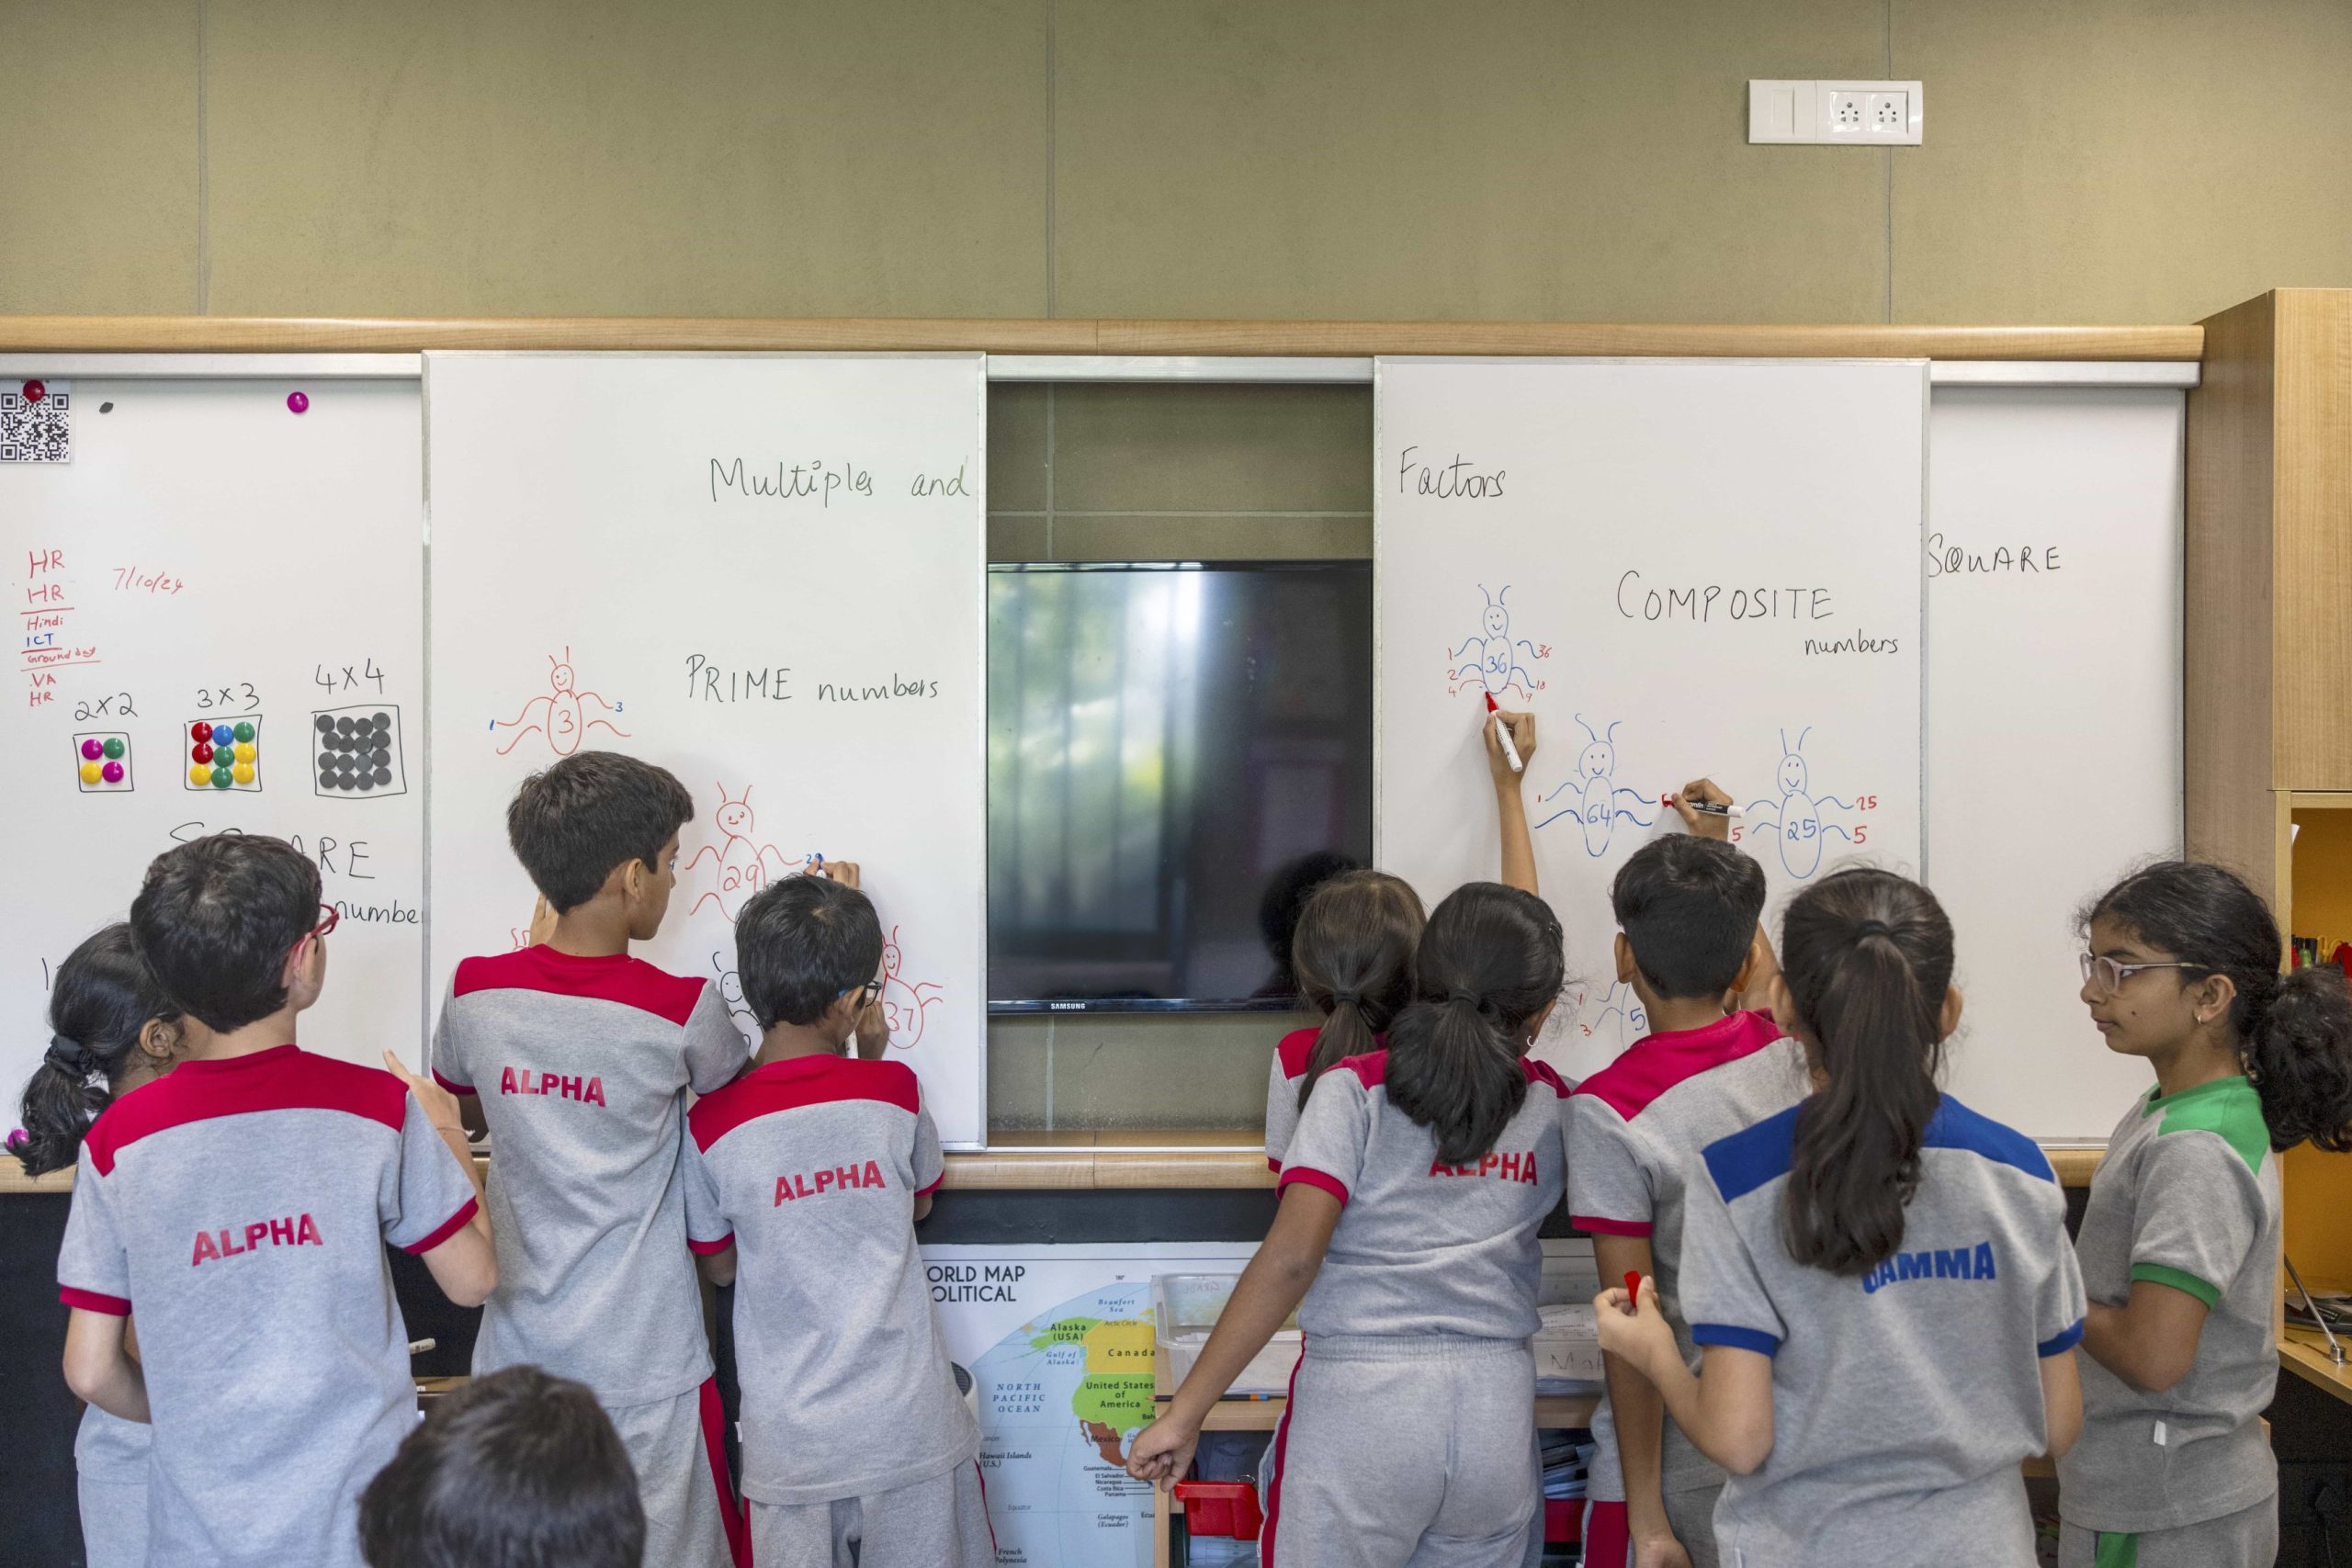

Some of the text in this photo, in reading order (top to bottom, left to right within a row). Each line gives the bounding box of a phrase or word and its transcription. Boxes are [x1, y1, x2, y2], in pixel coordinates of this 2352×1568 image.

[710, 456, 971, 507] Multiples and
[1399, 446, 1508, 499] Factors
[29, 548, 65, 580] HR
[28, 583, 65, 604] HR
[1616, 570, 1835, 622] COMPOSITE
[27, 615, 64, 631] Hindi
[26, 633, 54, 648] ICT
[1804, 628, 1899, 655] numbers
[1486, 652, 1507, 673] 36
[685, 654, 939, 703] PRIME numbers
[29, 691, 54, 707] HR
[615, 702, 624, 713] 3
[559, 709, 575, 734] 3
[1587, 803, 1611, 828] 64
[1787, 818, 1817, 841] 25
[1854, 825, 1869, 844] 5
[723, 863, 761, 893] 29
[334, 899, 424, 924] numbe
[884, 1001, 914, 1032] 37
[500, 1066, 606, 1108] ALPHA
[774, 1159, 886, 1208] ALPHA
[191, 1213, 323, 1267] ALPHA
[926, 1266, 1025, 1282] ORLD MAP
[932, 1286, 1017, 1302] OLITICAL
[1050, 1323, 1086, 1332] Alaska
[1108, 1348, 1155, 1358] Canada
[1086, 1382, 1155, 1390] United States
[1100, 1400, 1141, 1408] America
